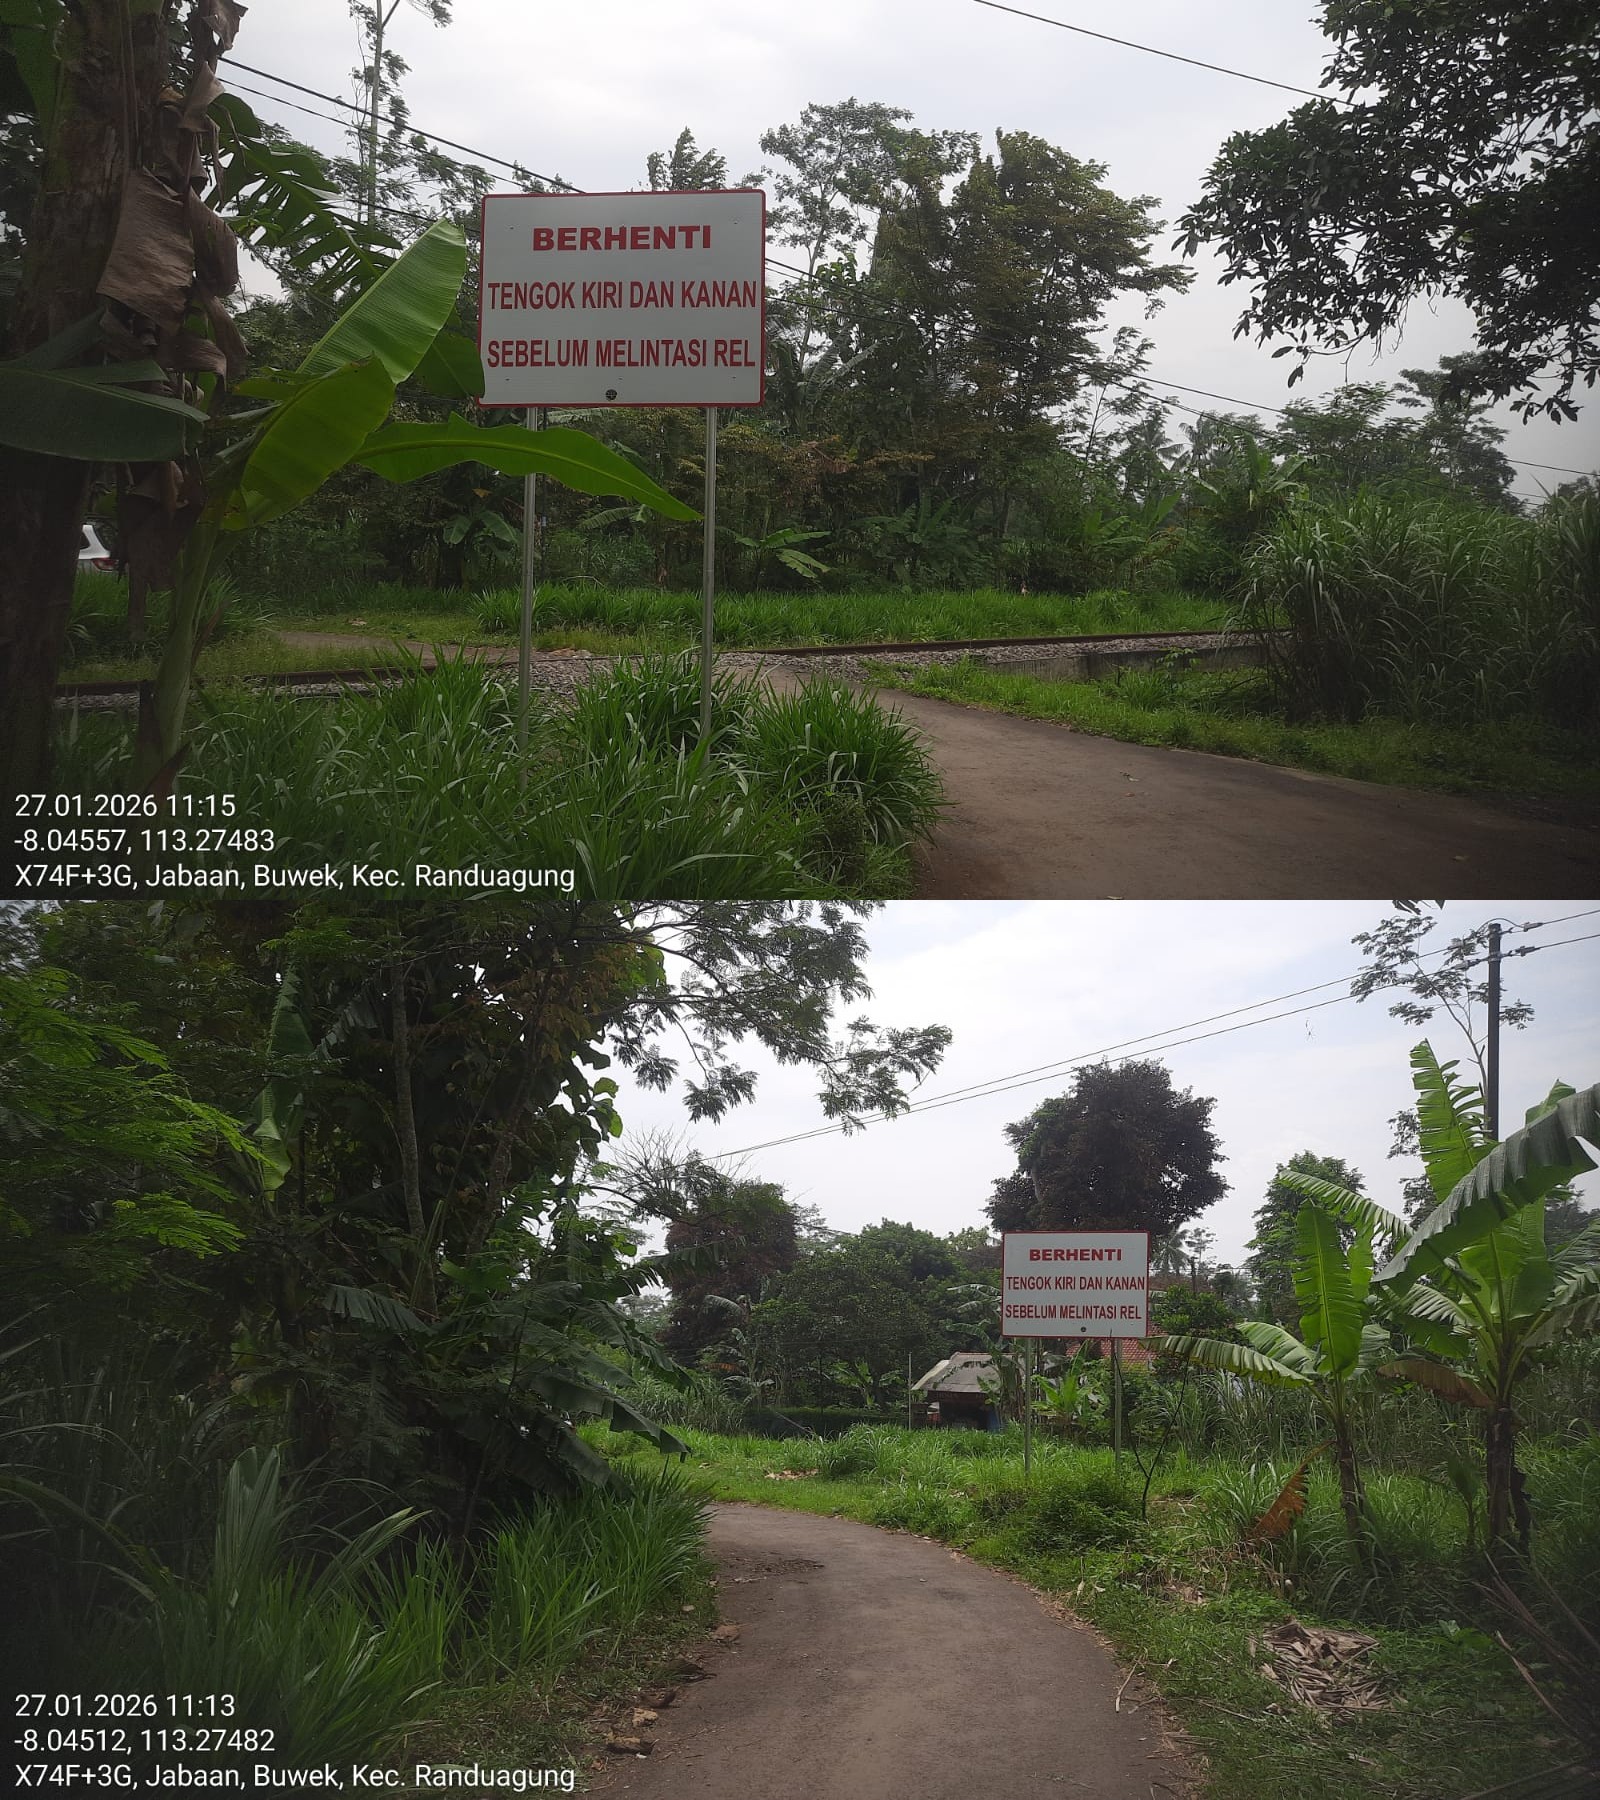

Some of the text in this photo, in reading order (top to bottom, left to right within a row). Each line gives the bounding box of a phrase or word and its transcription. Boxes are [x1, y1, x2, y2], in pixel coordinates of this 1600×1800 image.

[533, 225, 711, 251] BERHENTI
[488, 280, 757, 309] TENGOK KIRI DAN KANAN
[487, 339, 756, 368] SEBELUM MELINTASI REL
[1029, 1248, 1122, 1261] BERHENTI
[1006, 1276, 1145, 1290] TENGOK KIRI DAN KANAN
[1005, 1304, 1142, 1319] SEBELUM MELINTASI REL
